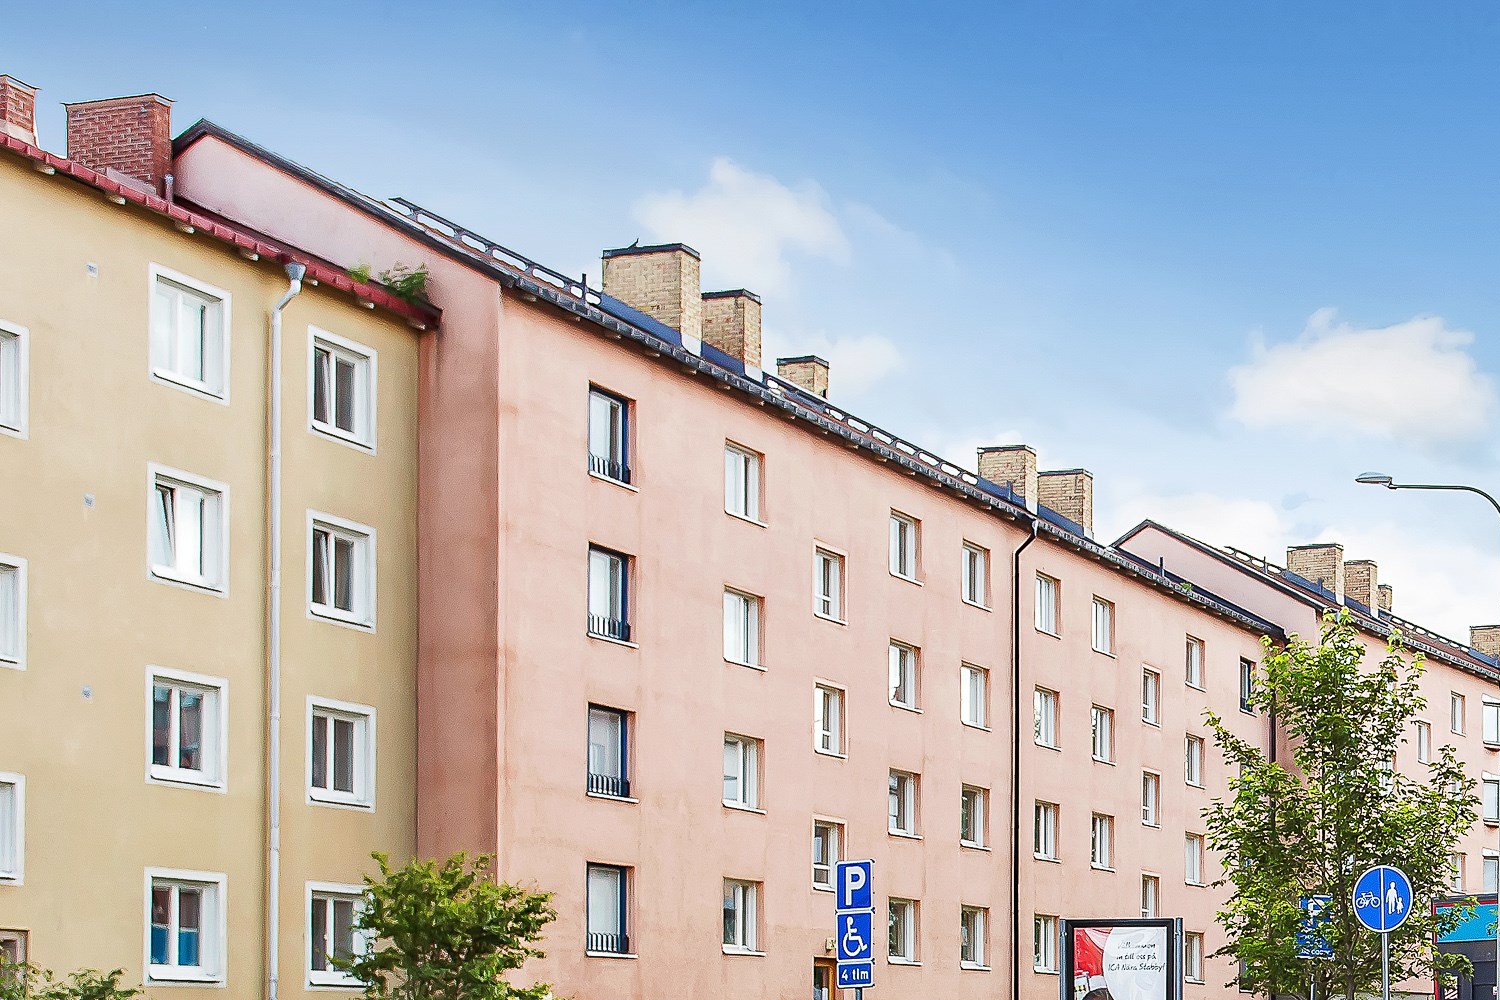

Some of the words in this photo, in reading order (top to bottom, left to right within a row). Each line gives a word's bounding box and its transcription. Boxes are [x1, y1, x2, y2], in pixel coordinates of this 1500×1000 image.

[845, 866, 866, 906] P
[1146, 952, 1157, 961] på
[841, 968, 849, 981] 4
